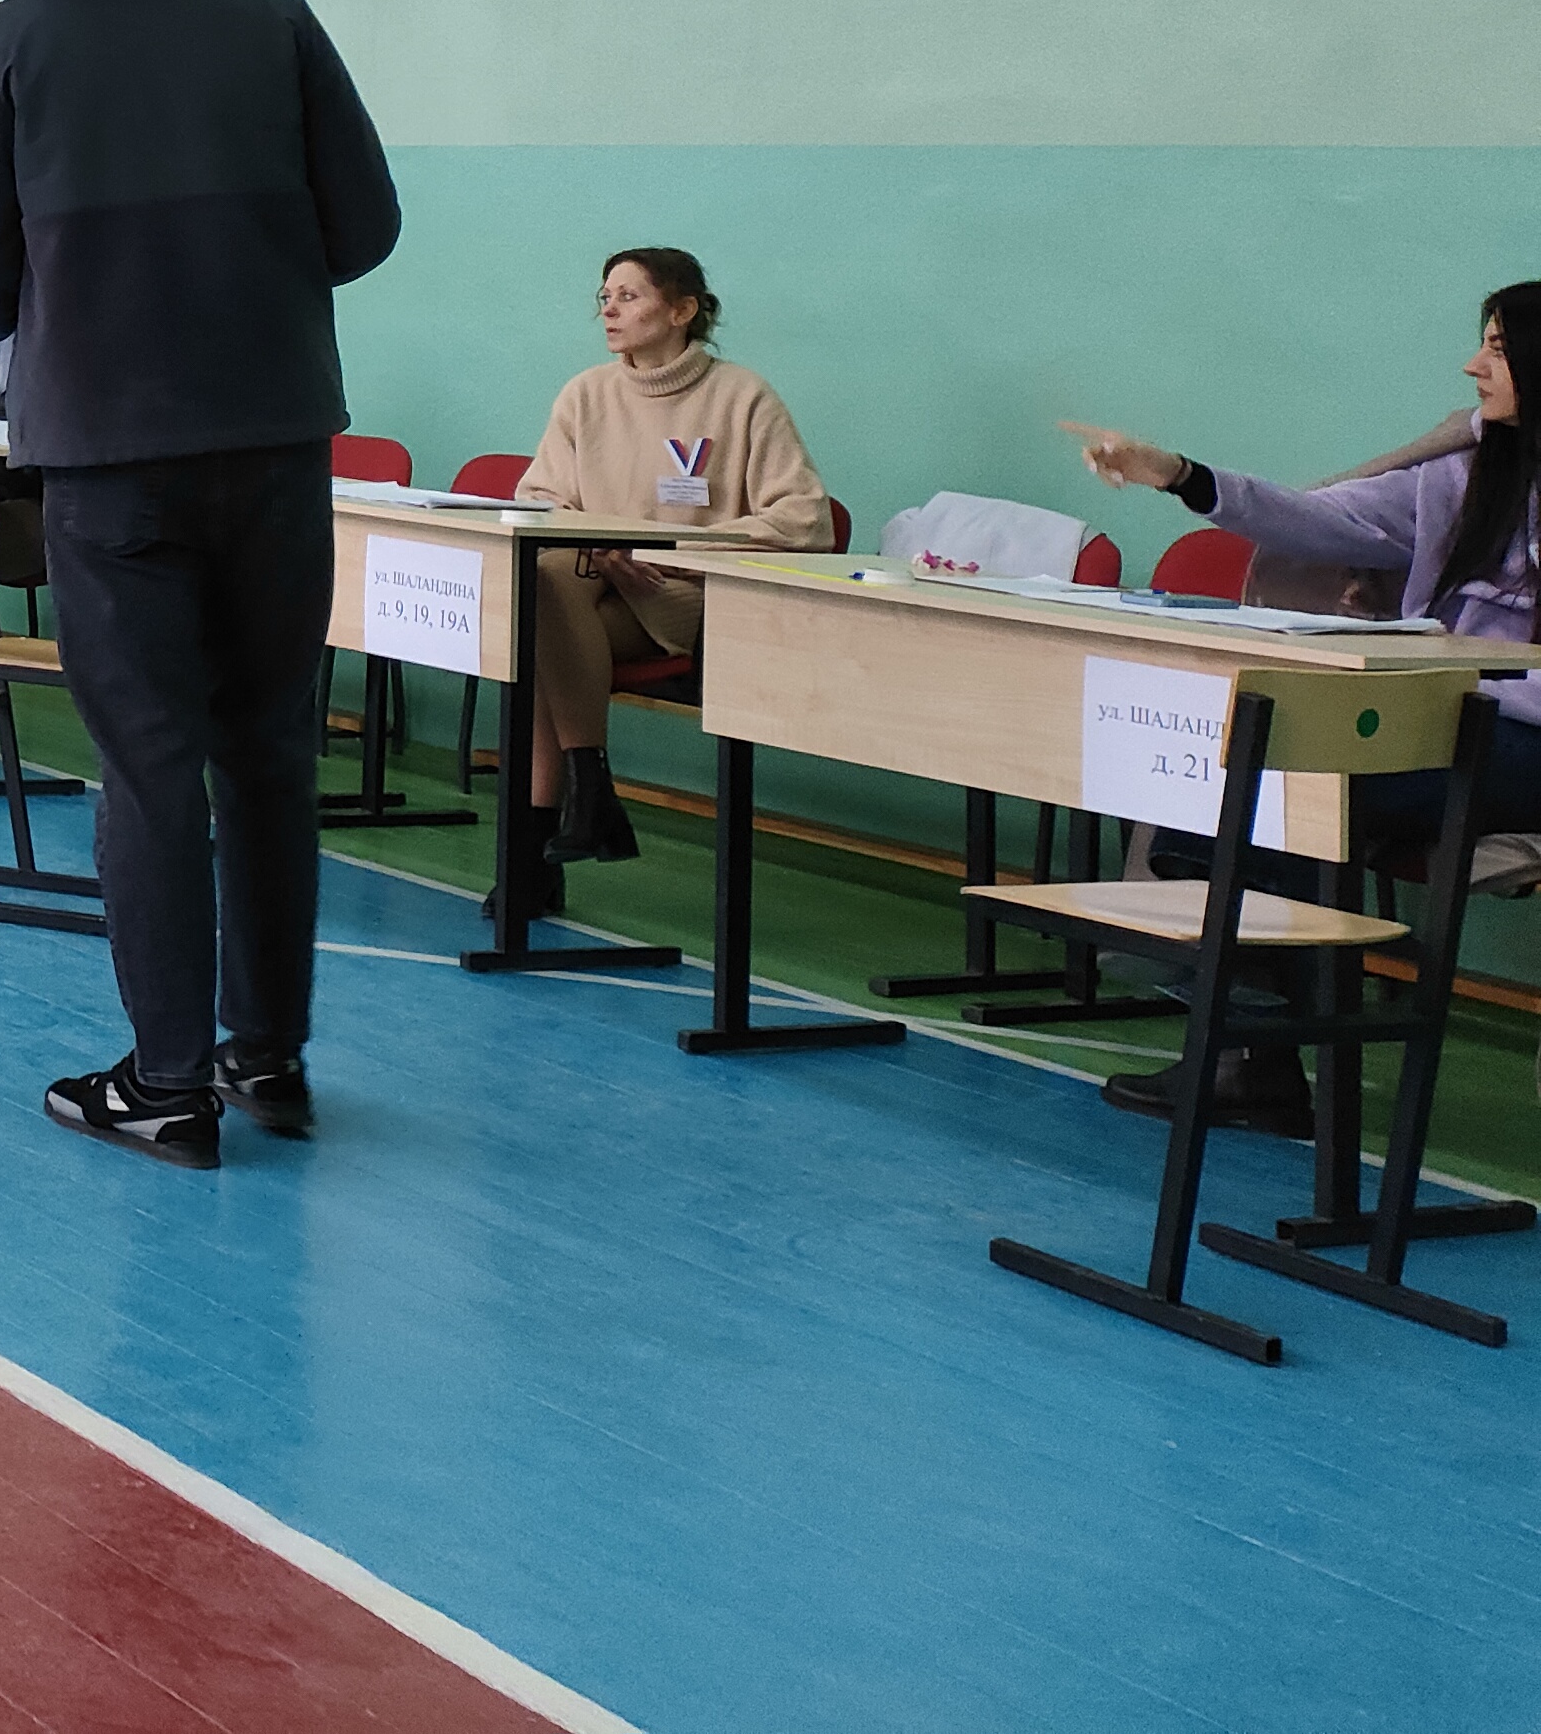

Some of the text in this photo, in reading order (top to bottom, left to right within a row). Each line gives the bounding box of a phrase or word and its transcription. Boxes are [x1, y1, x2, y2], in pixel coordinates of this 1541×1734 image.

[375, 571, 476, 601] ул. ШАЛАНДИНА
[378, 599, 470, 634] д. 9, 19, 19А
[1098, 704, 1124, 722] ул.
[1151, 753, 1210, 782] д. 21
